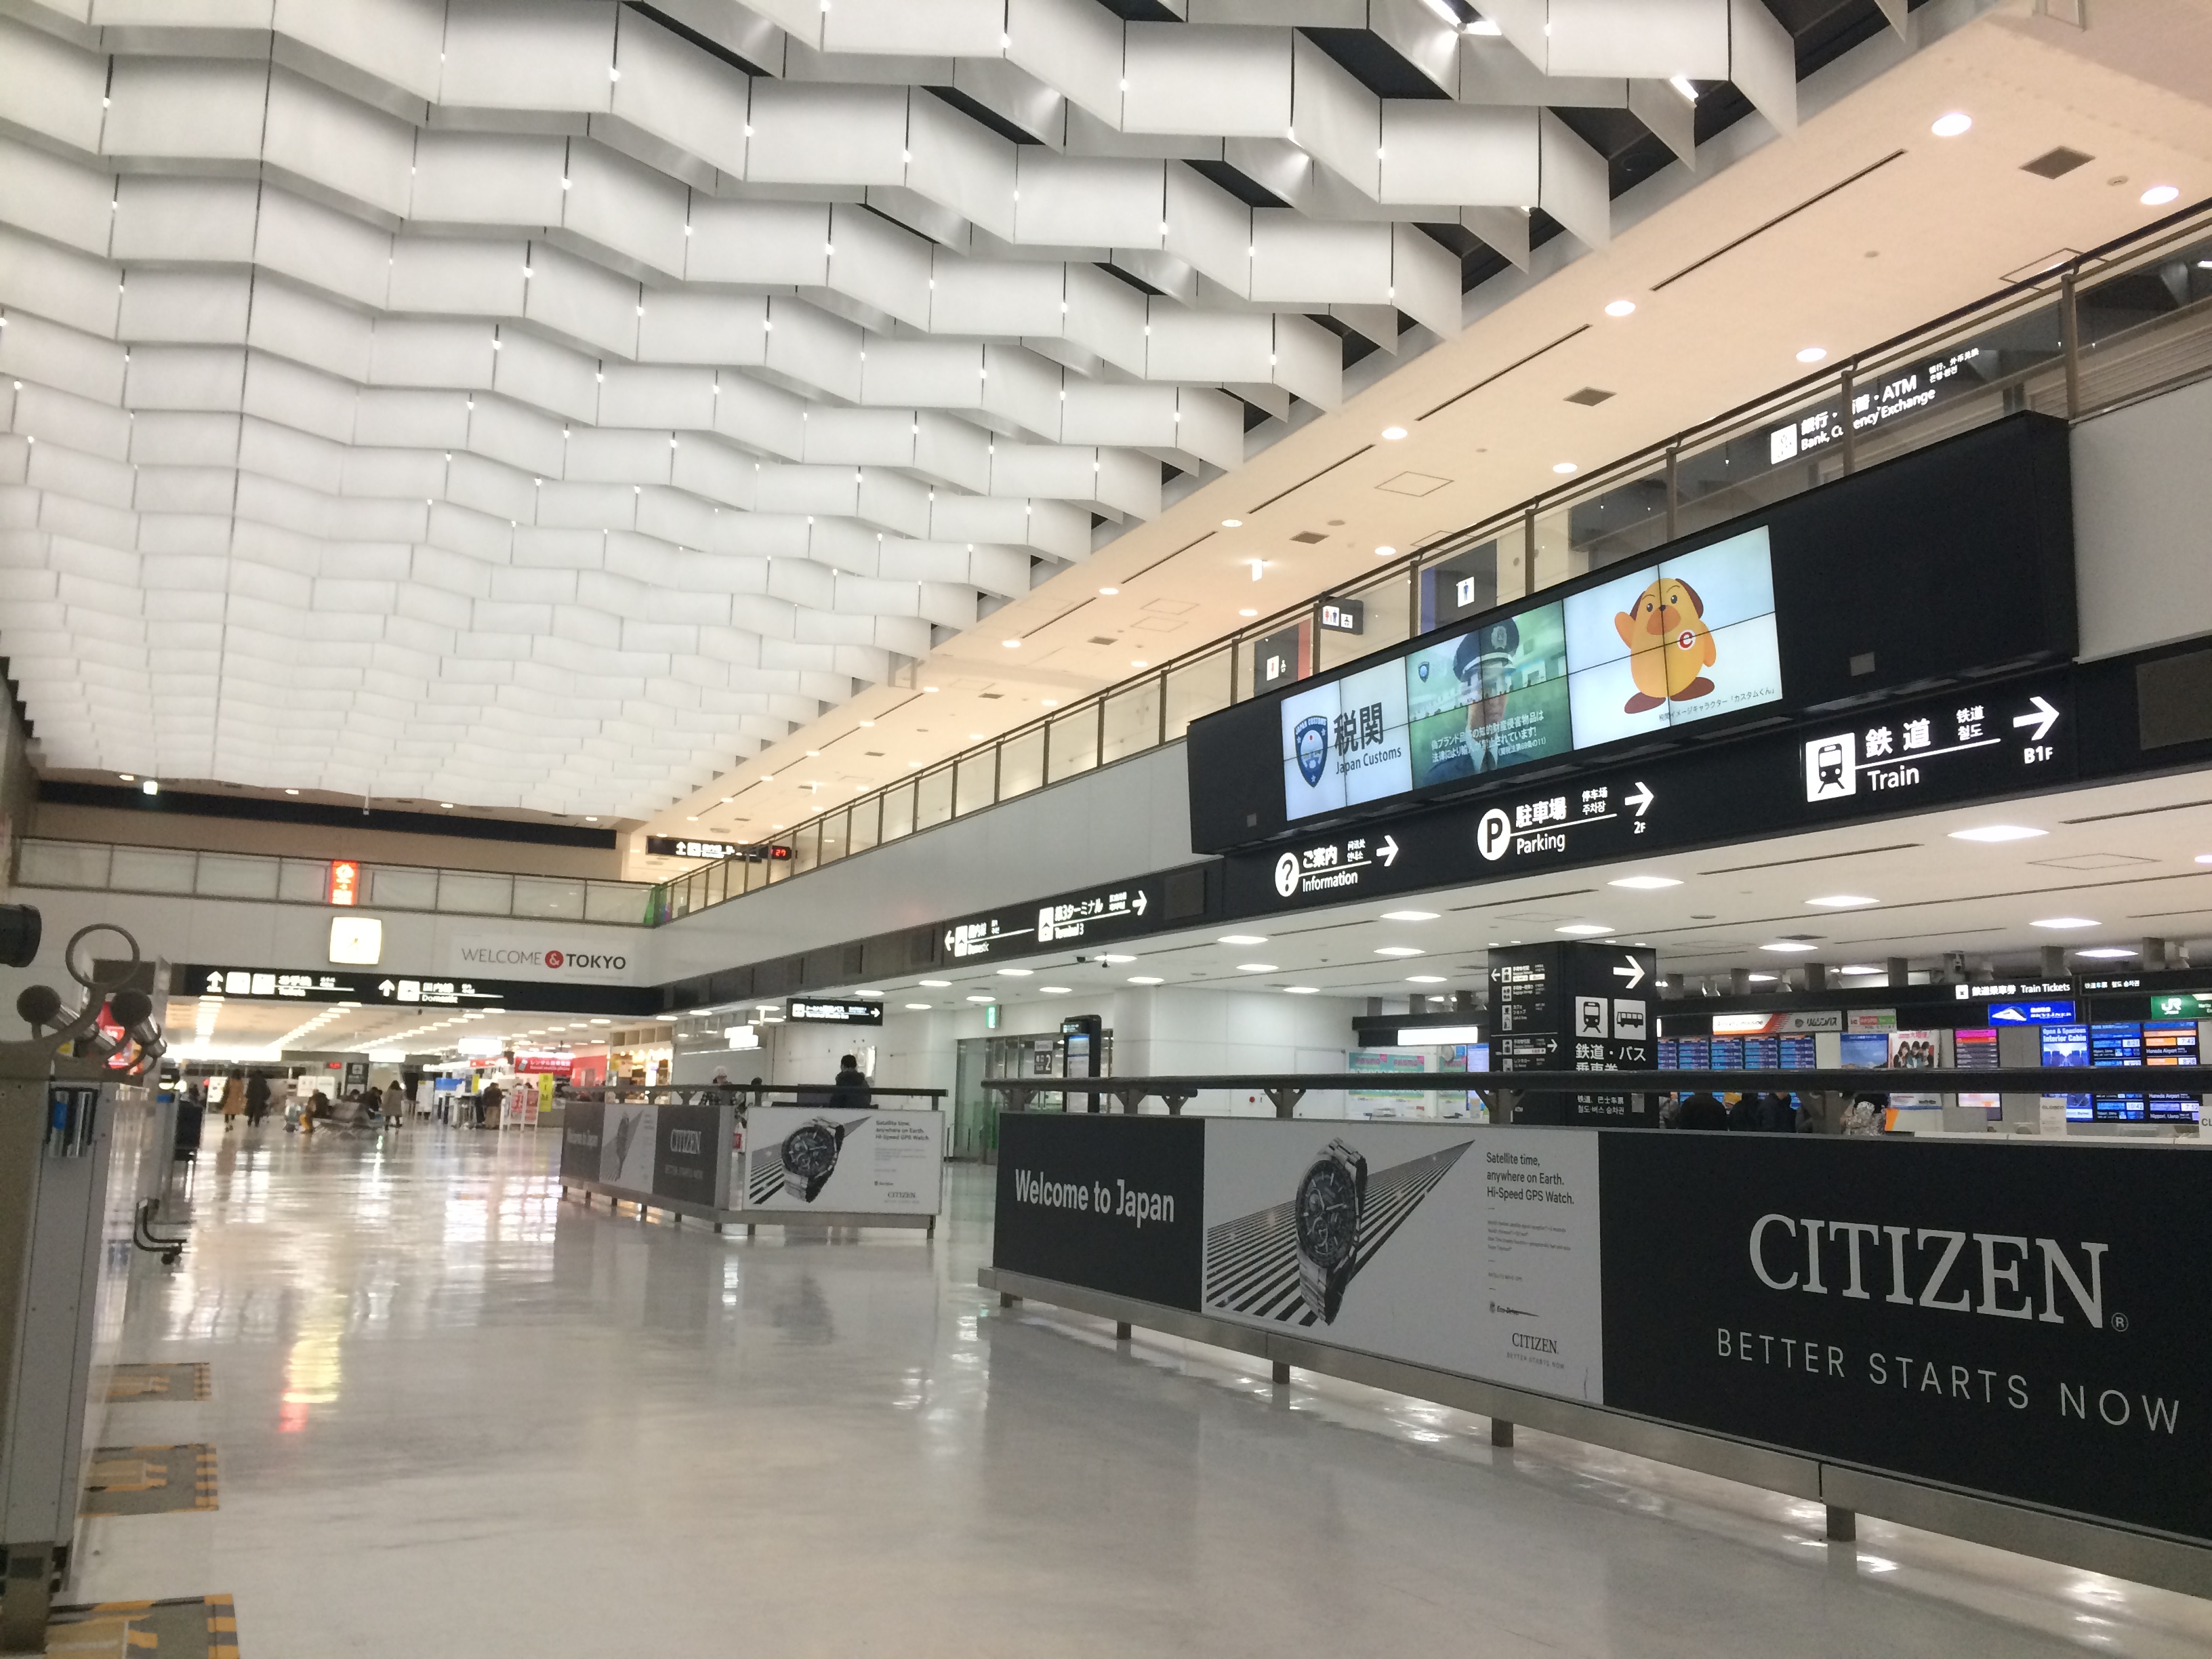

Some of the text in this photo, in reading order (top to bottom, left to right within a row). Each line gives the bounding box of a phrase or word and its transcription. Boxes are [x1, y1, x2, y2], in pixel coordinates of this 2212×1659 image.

[1801, 388, 1936, 451] Bank, Cuency Exchange
[1295, 717, 1326, 735] JAPAN CUSTOMS
[1334, 702, 1384, 756] 税関
[1958, 724, 1983, 741] 철도
[1336, 747, 1401, 775] Japan Customs
[2024, 745, 2053, 764] B1F
[1867, 765, 1919, 791] Train
[1582, 787, 1607, 802] 停车场
[1515, 796, 1566, 828] 駐車場
[1582, 800, 1606, 815] 주차장
[1633, 821, 1646, 834] 2F
[1517, 833, 1565, 855] Parking
[1303, 844, 1337, 868] ご案内
[1303, 871, 1358, 892] Information
[1054, 923, 1084, 939] Terminal 3
[462, 948, 542, 965] WELCOME
[566, 954, 626, 970] TOKYO
[2020, 983, 2070, 994] Train Tickets
[2161, 998, 2182, 1011] JR
[1806, 1017, 1837, 1027] リムジンバス
[1576, 1043, 1646, 1061] 鉄道・バス
[1046, 1054, 1050, 1071] 2
[541, 1074, 549, 1101] SIM
[1486, 1152, 1540, 1167] Satellite time,
[1487, 1170, 1564, 1185] anywhere on Earth.
[1015, 1168, 1174, 1228] Welcome to Japan
[1487, 1186, 1574, 1204] Hi-Speed GPS Watch.
[1512, 1332, 1557, 1354] CITIZEN
[1507, 1352, 1527, 1361] BETTER
[1529, 1357, 1550, 1367] STARTS
[1717, 1328, 2179, 1435] BETTER STARTS NOW
